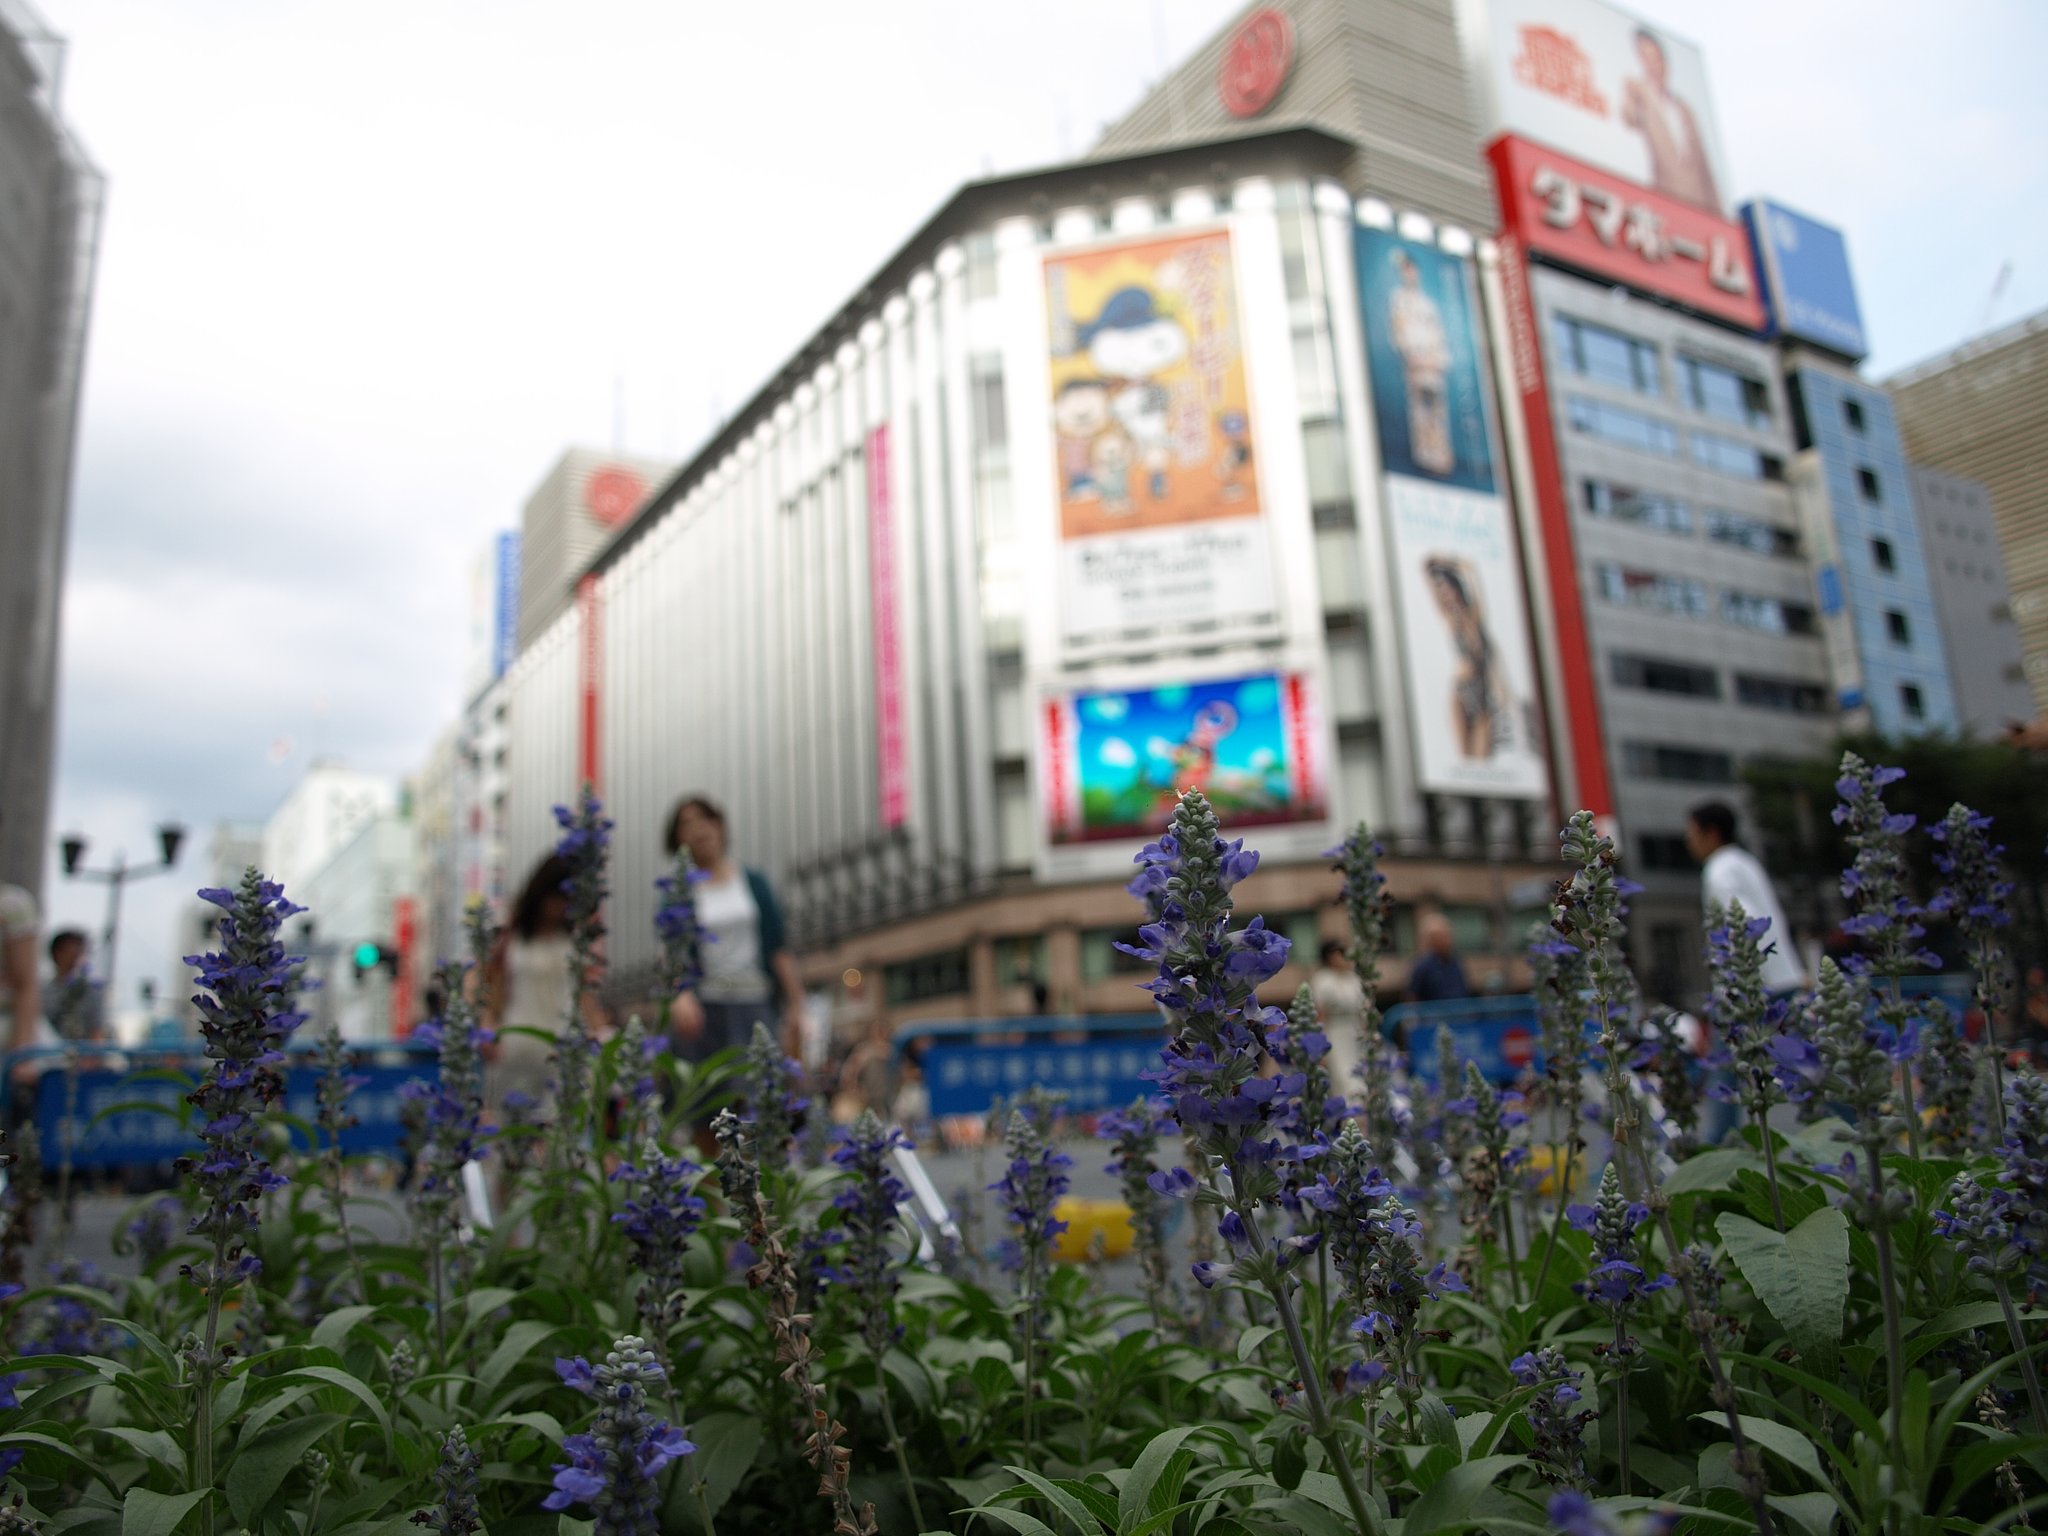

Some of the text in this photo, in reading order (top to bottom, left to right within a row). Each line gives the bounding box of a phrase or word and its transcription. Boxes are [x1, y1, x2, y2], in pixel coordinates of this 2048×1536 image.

[1532, 166, 1751, 294] タマホーム
